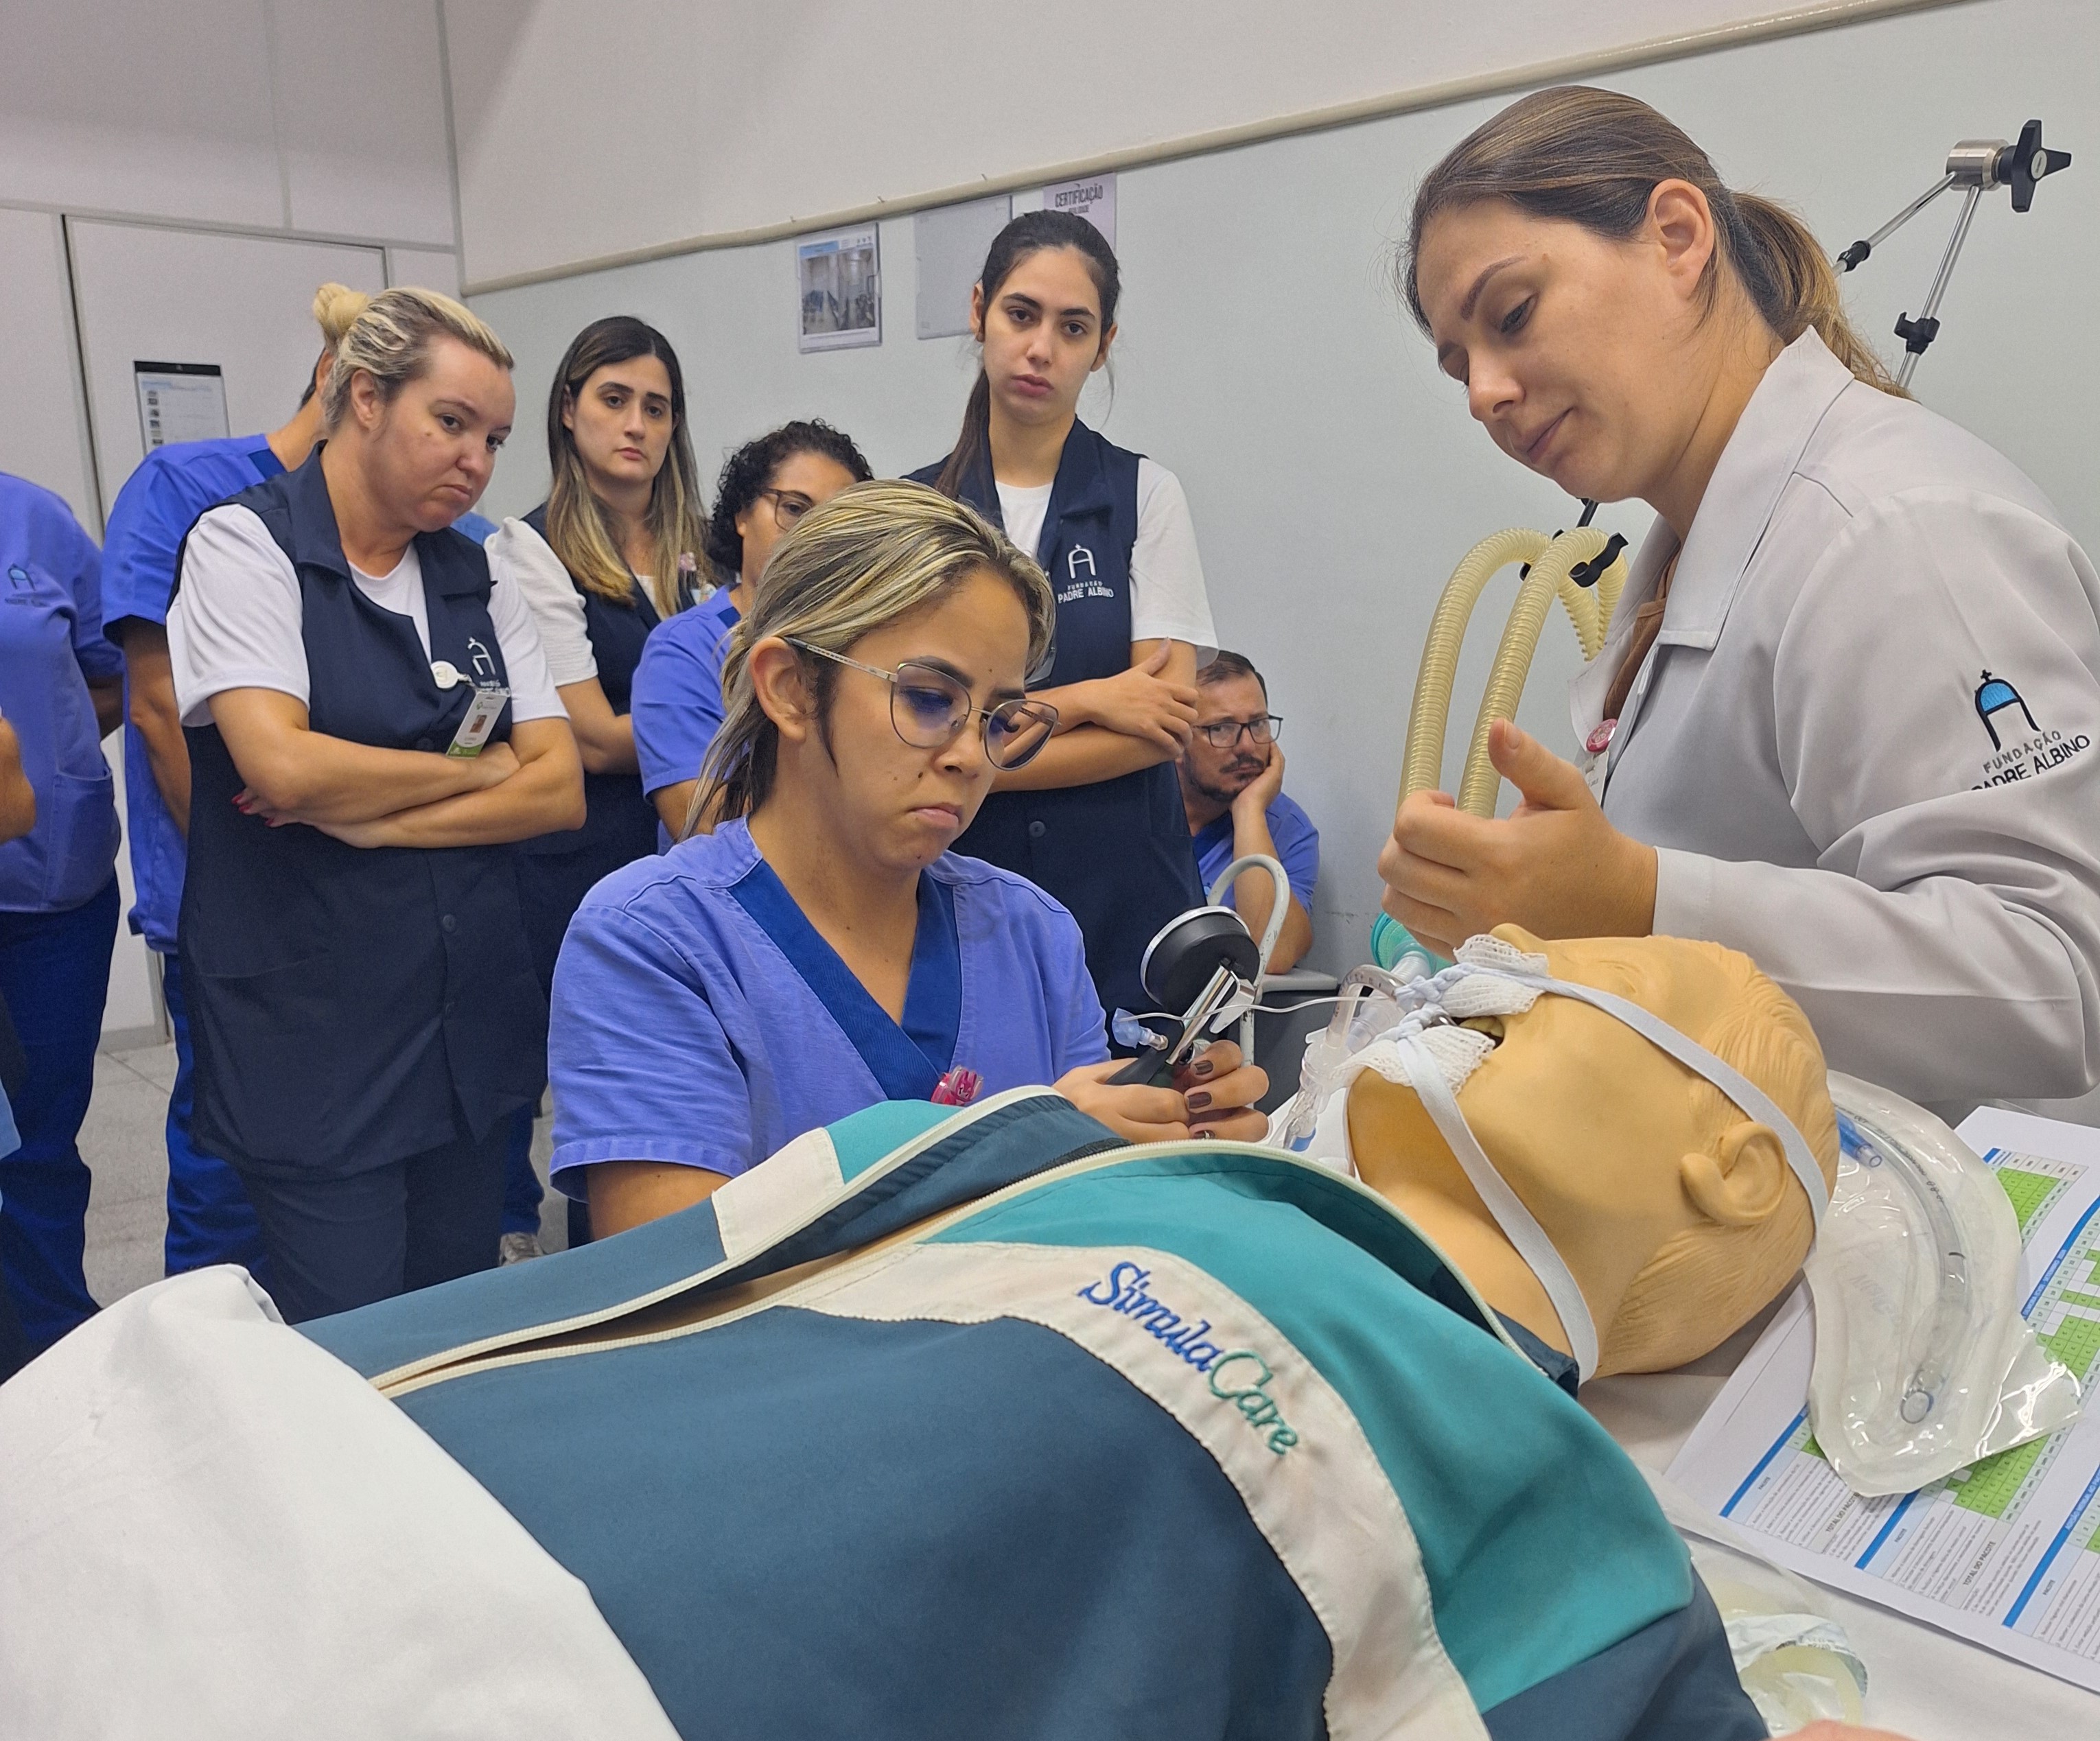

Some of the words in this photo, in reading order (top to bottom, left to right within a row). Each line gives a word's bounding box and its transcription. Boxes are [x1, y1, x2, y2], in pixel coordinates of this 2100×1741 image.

[1058, 588, 1084, 604] PADRE
[1971, 762, 2032, 791] ADRE
[2033, 734, 2090, 775] ALBINO
[1983, 730, 2062, 773] FUNDAÇÃO
[1076, 1261, 1298, 1456] SimulaCare
[1962, 1570, 1977, 1585] TOTAL
[1979, 1541, 1996, 1561] PACOTE
